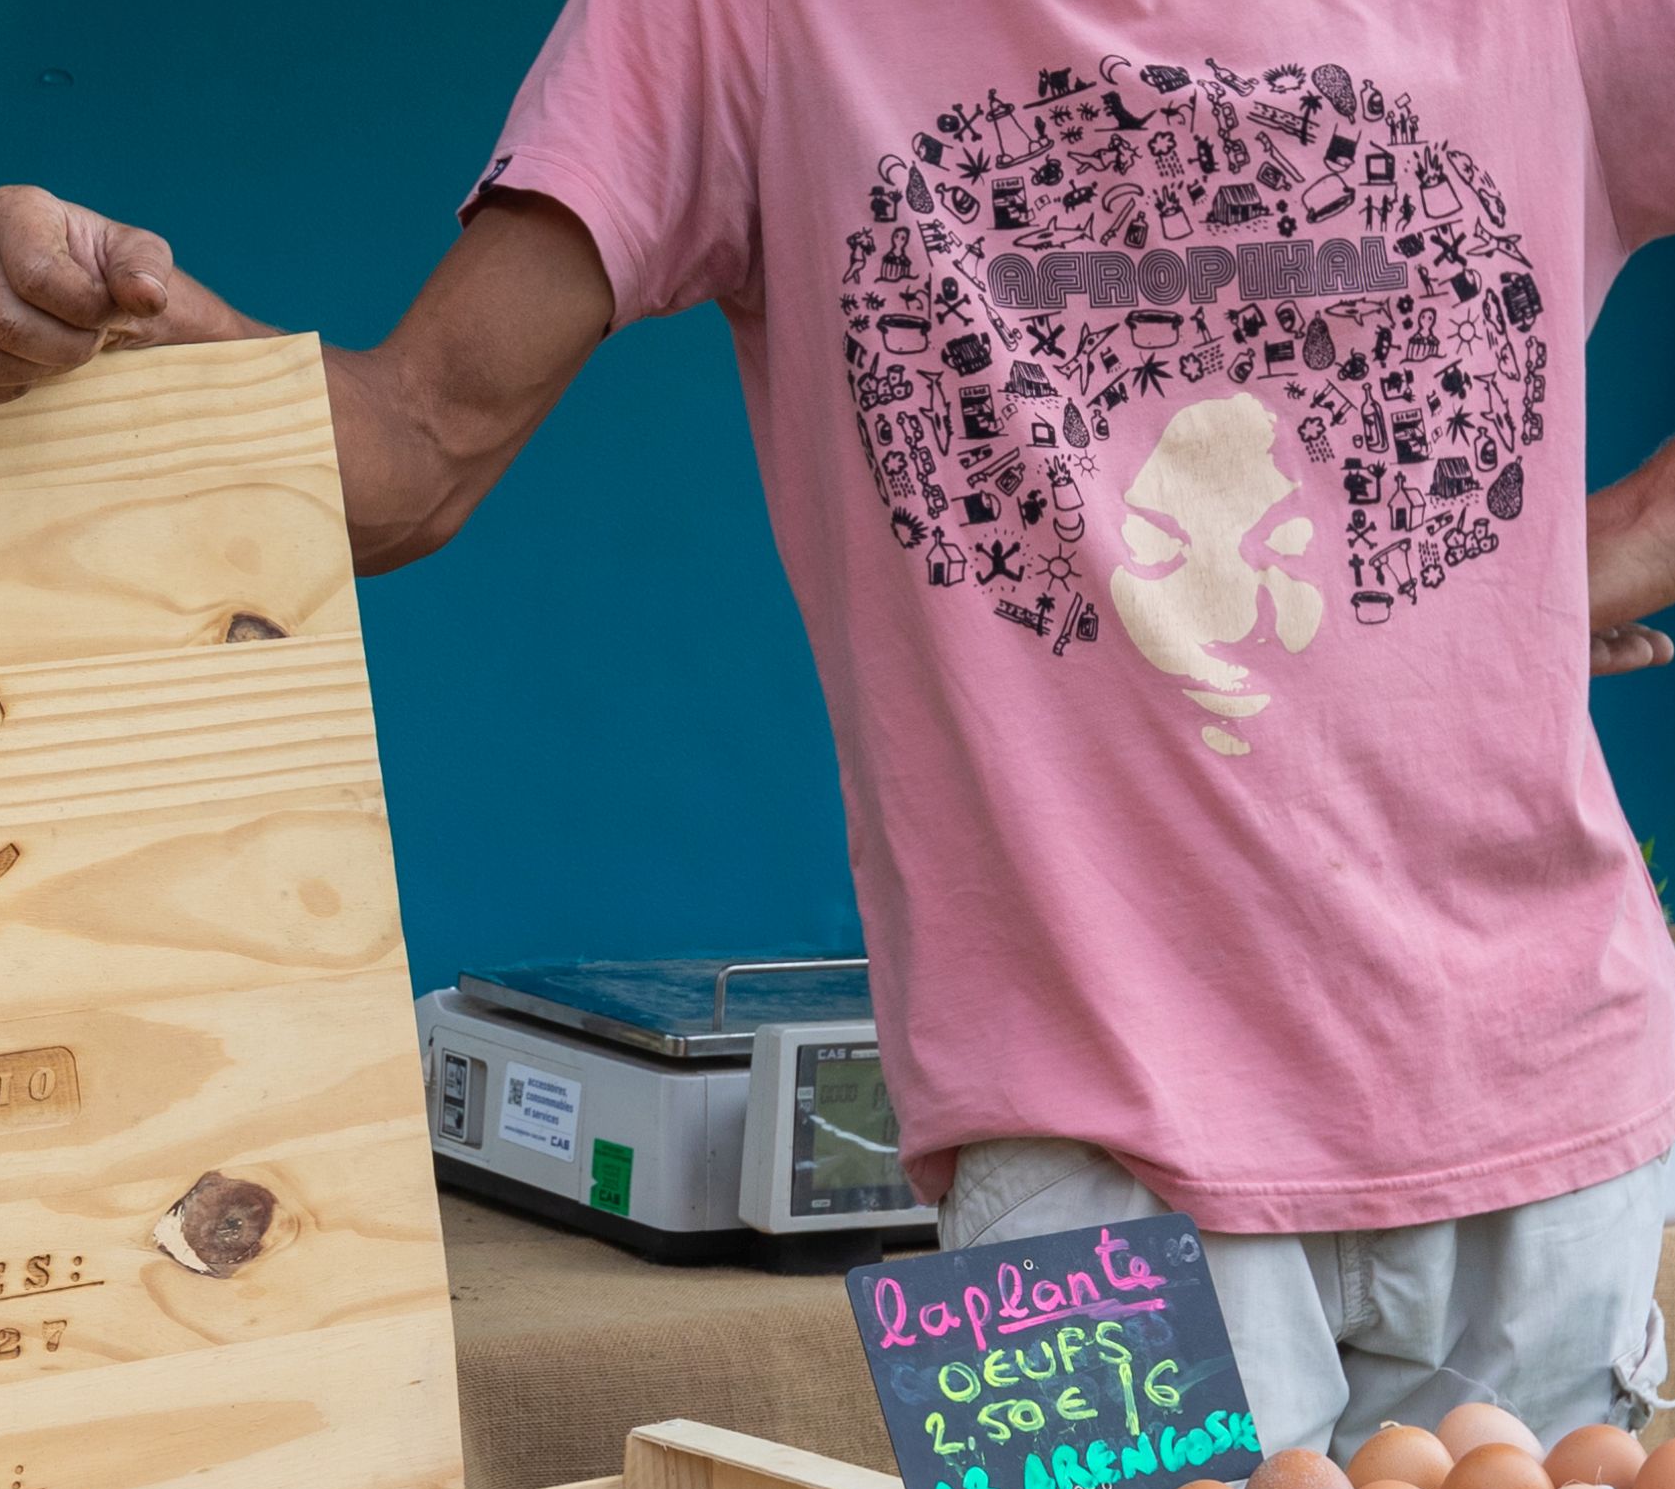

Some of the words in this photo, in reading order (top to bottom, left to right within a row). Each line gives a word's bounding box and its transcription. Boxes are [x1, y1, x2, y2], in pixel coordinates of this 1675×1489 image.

[987, 235, 1408, 309] AFROPIKAL
[818, 1049, 846, 1060] CAS
[875, 1228, 1166, 1351] laplante
[937, 1320, 1132, 1404] OEUFS
